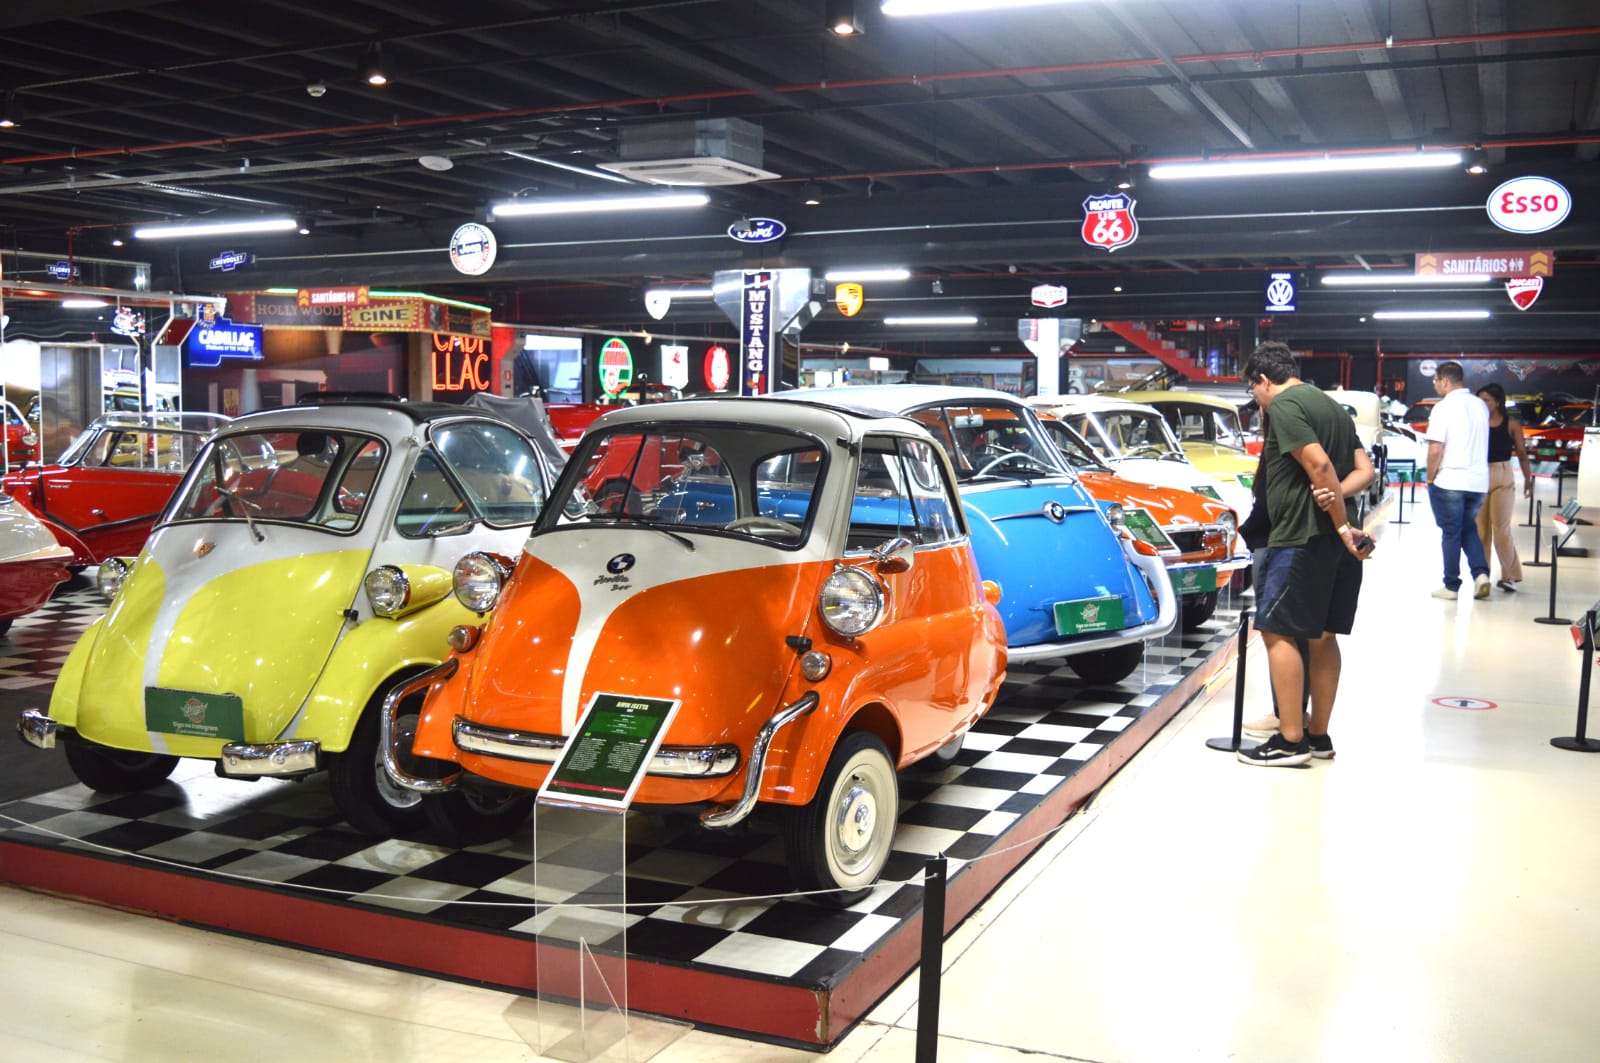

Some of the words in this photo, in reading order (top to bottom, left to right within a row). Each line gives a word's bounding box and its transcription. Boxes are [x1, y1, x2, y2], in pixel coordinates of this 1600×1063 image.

[1089, 199, 1123, 211] ROUTE
[1093, 218, 1124, 243] 66
[213, 255, 243, 266] CHEVROLET
[1443, 256, 1507, 273] SANITÁRIOS
[1509, 278, 1540, 287] DUCATI
[311, 290, 346, 304] SANITÁRIOS
[257, 304, 342, 317] HOLLYWOOD
[359, 308, 410, 322] CINE
[748, 290, 766, 371] MUSTANG
[199, 329, 255, 347] CADILLAC
[432, 352, 489, 390] LLAC
